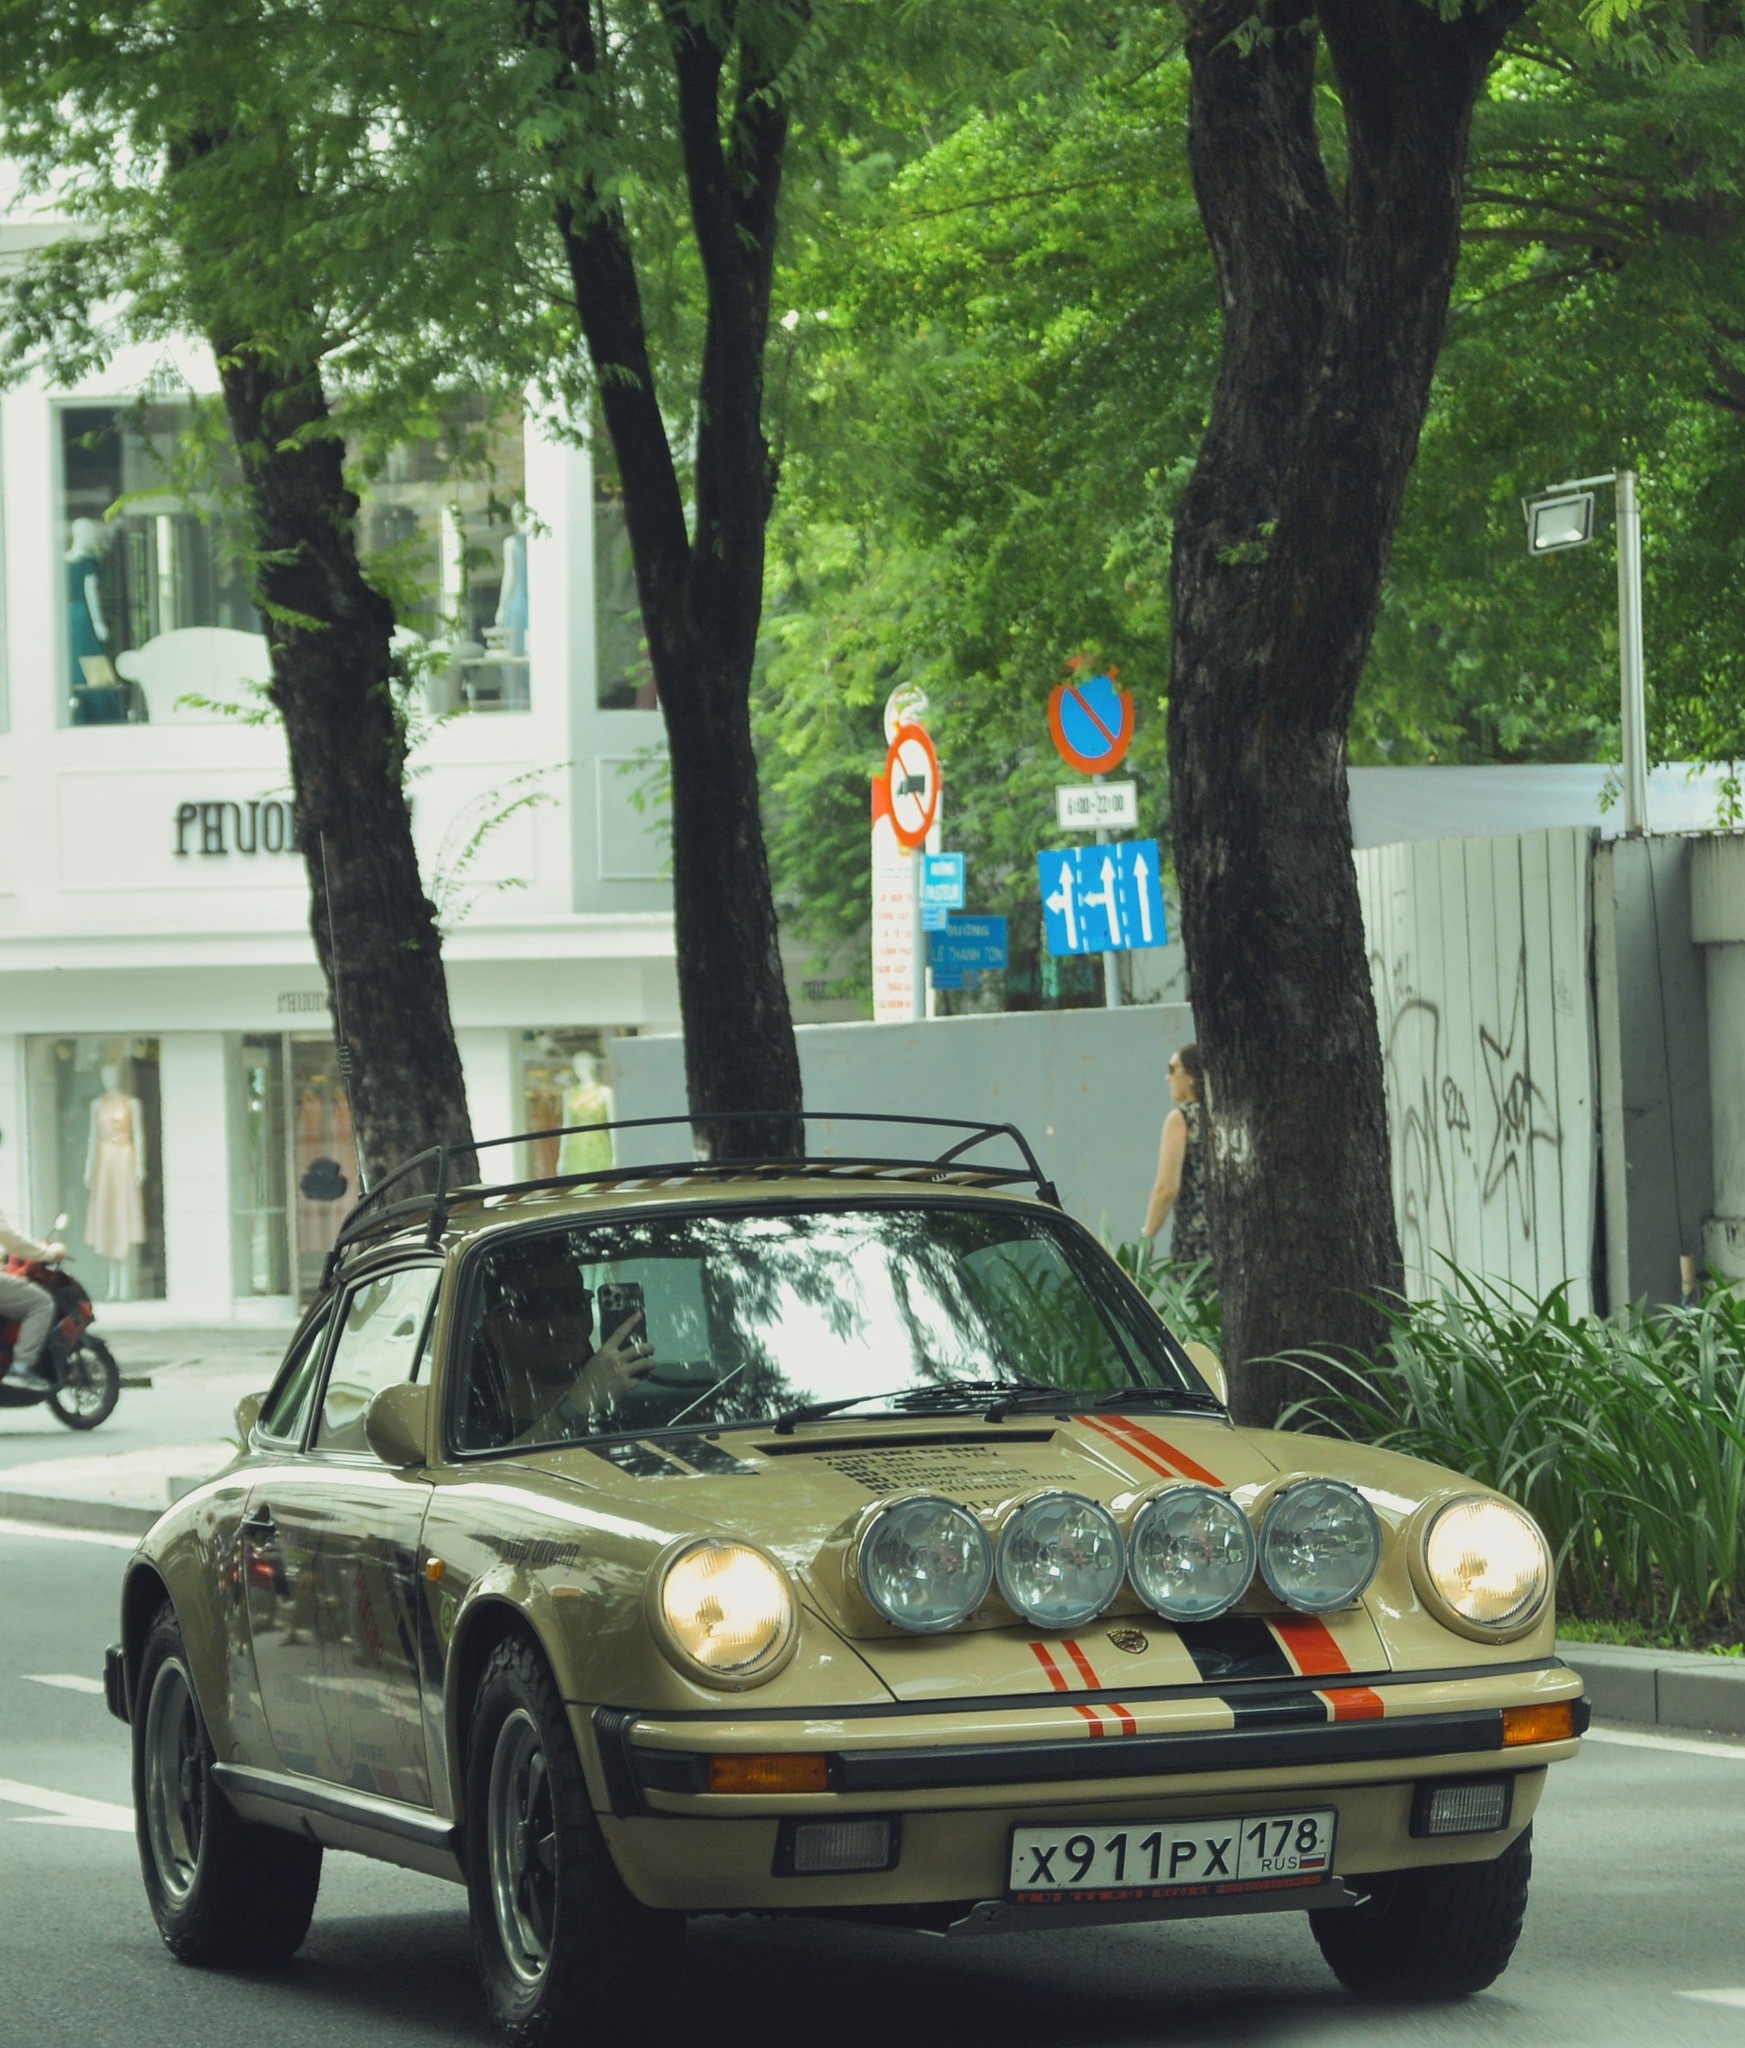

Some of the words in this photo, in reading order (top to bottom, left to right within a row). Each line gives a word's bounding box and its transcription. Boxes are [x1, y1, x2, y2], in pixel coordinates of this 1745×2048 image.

[277, 991, 327, 1013] PHUON
[844, 1470, 879, 1478] NO
[855, 1476, 889, 1484] NO
[893, 1472, 957, 1481] brake
[963, 1467, 1029, 1476] assist
[865, 1482, 901, 1491] NO
[939, 1483, 1021, 1492] oblems
[1246, 1817, 1319, 1859] 178
[1261, 1856, 1298, 1873] RUS
